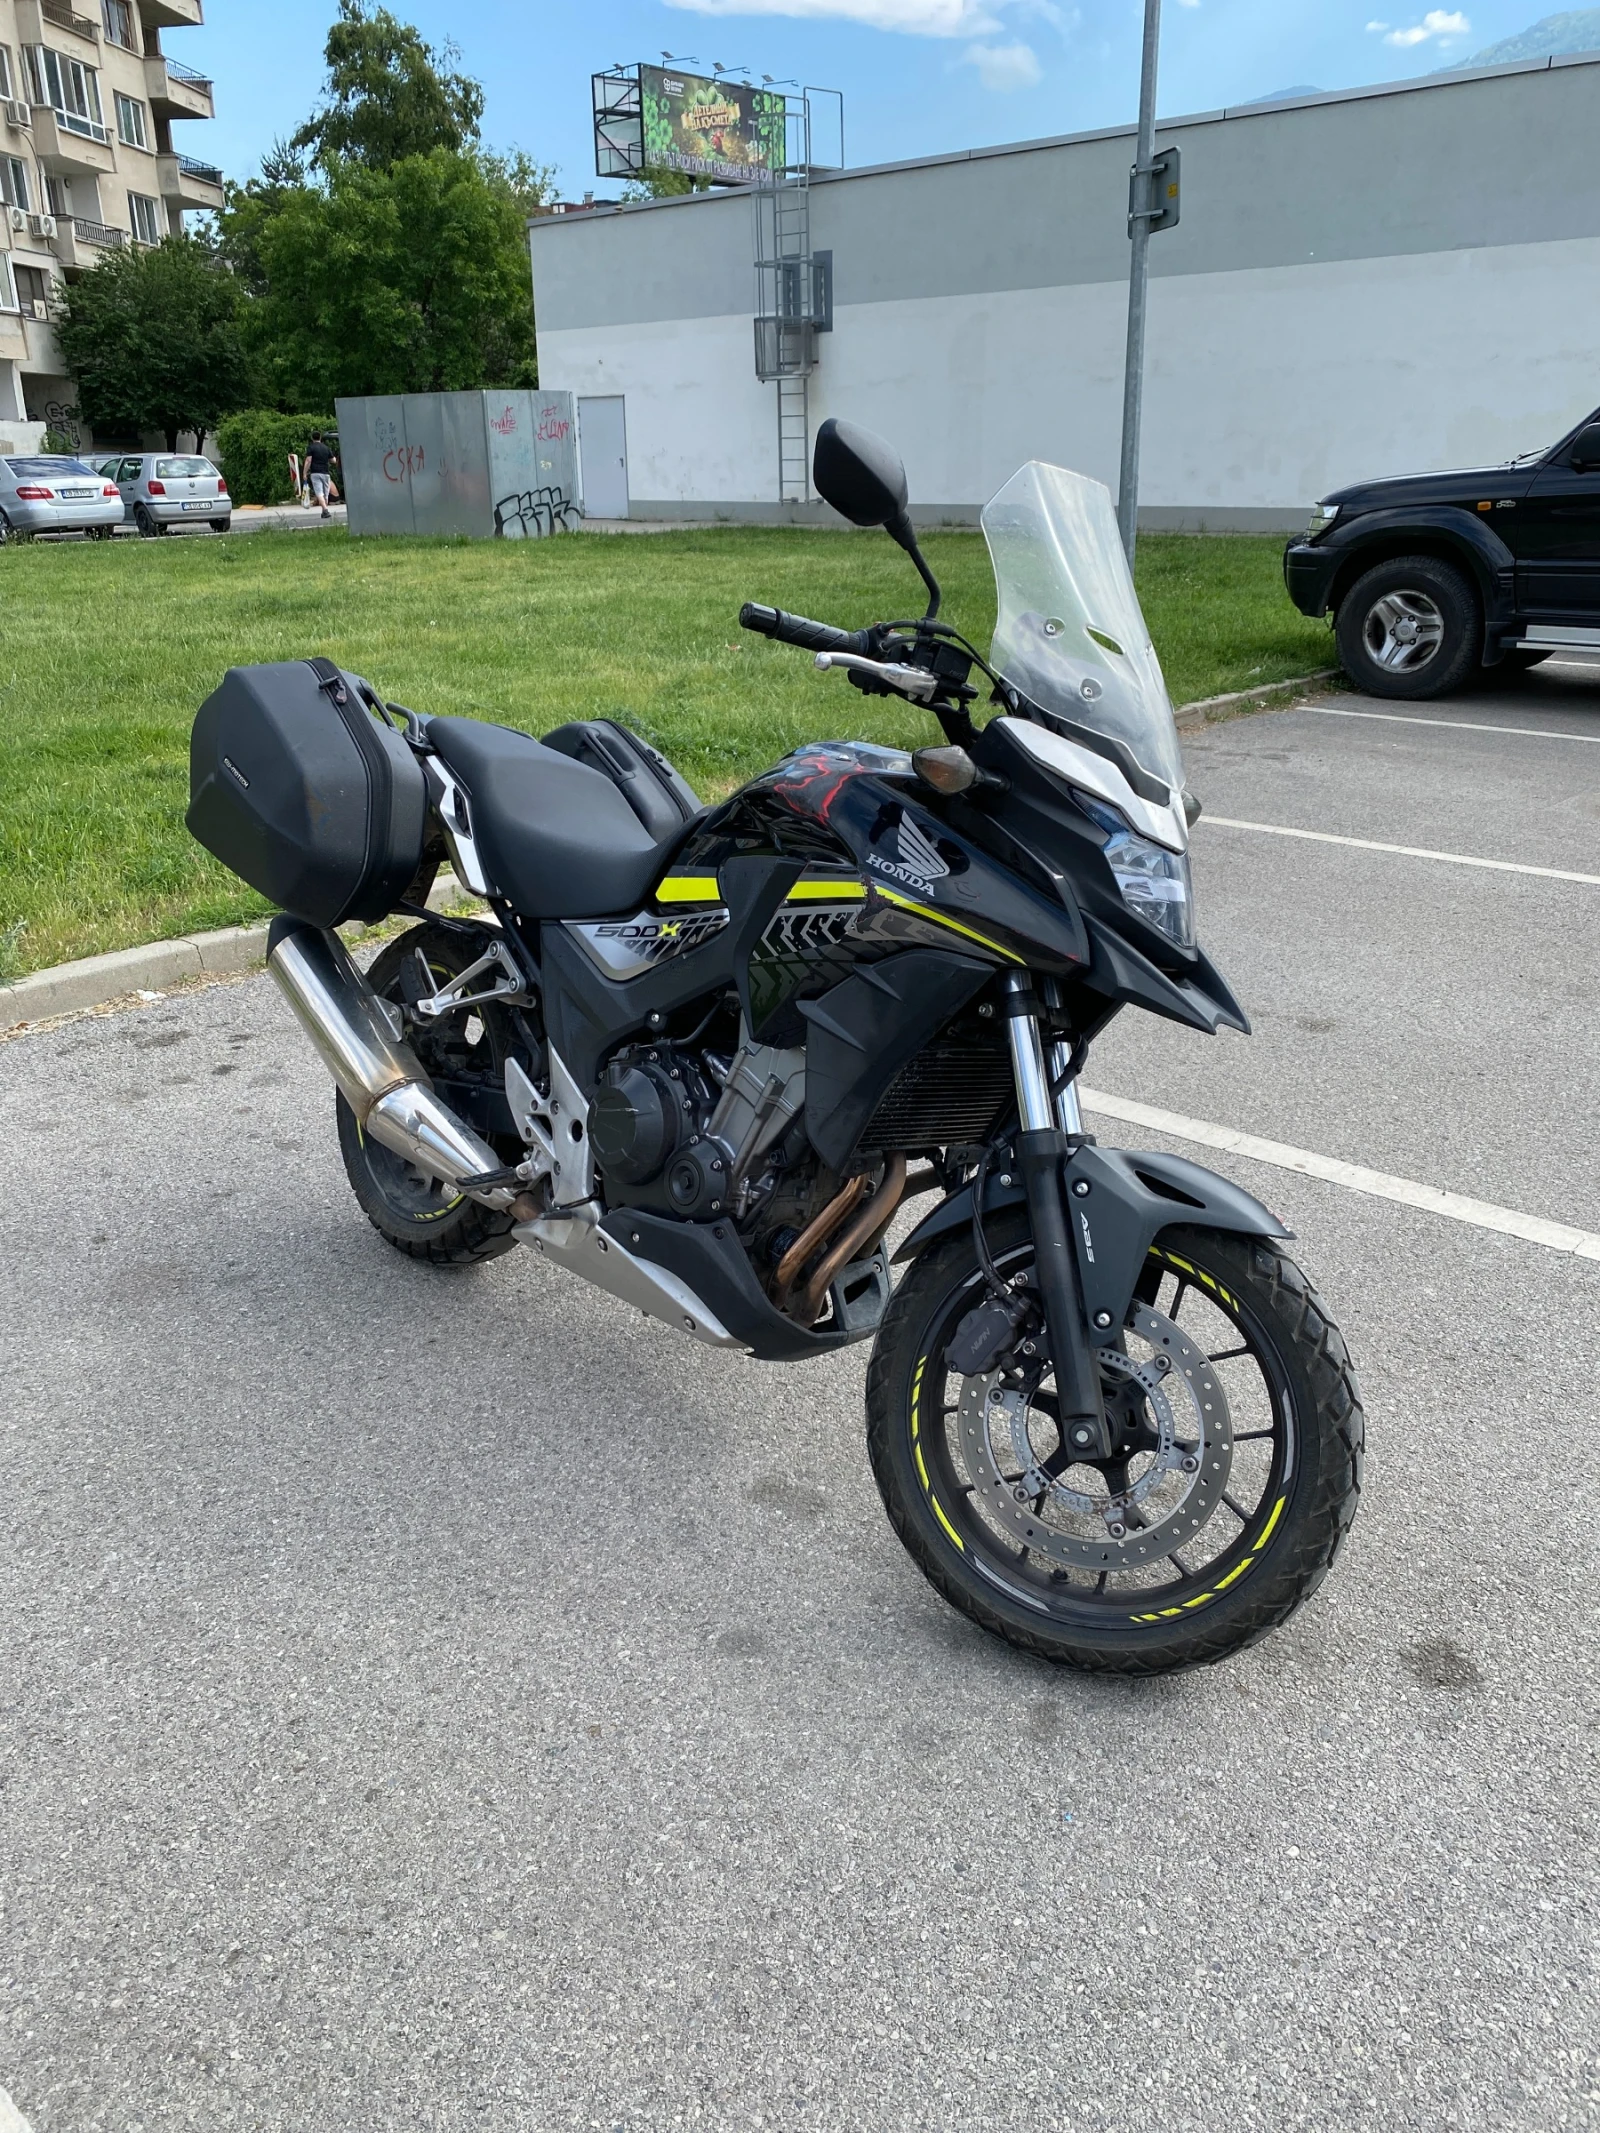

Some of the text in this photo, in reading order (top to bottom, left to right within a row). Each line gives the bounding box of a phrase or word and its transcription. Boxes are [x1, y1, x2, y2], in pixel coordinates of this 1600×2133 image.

[383, 445, 424, 483] CSKA
[866, 853, 935, 896] HONDA
[595, 923, 681, 937] 500X
[1080, 1211, 1095, 1263] ABS
